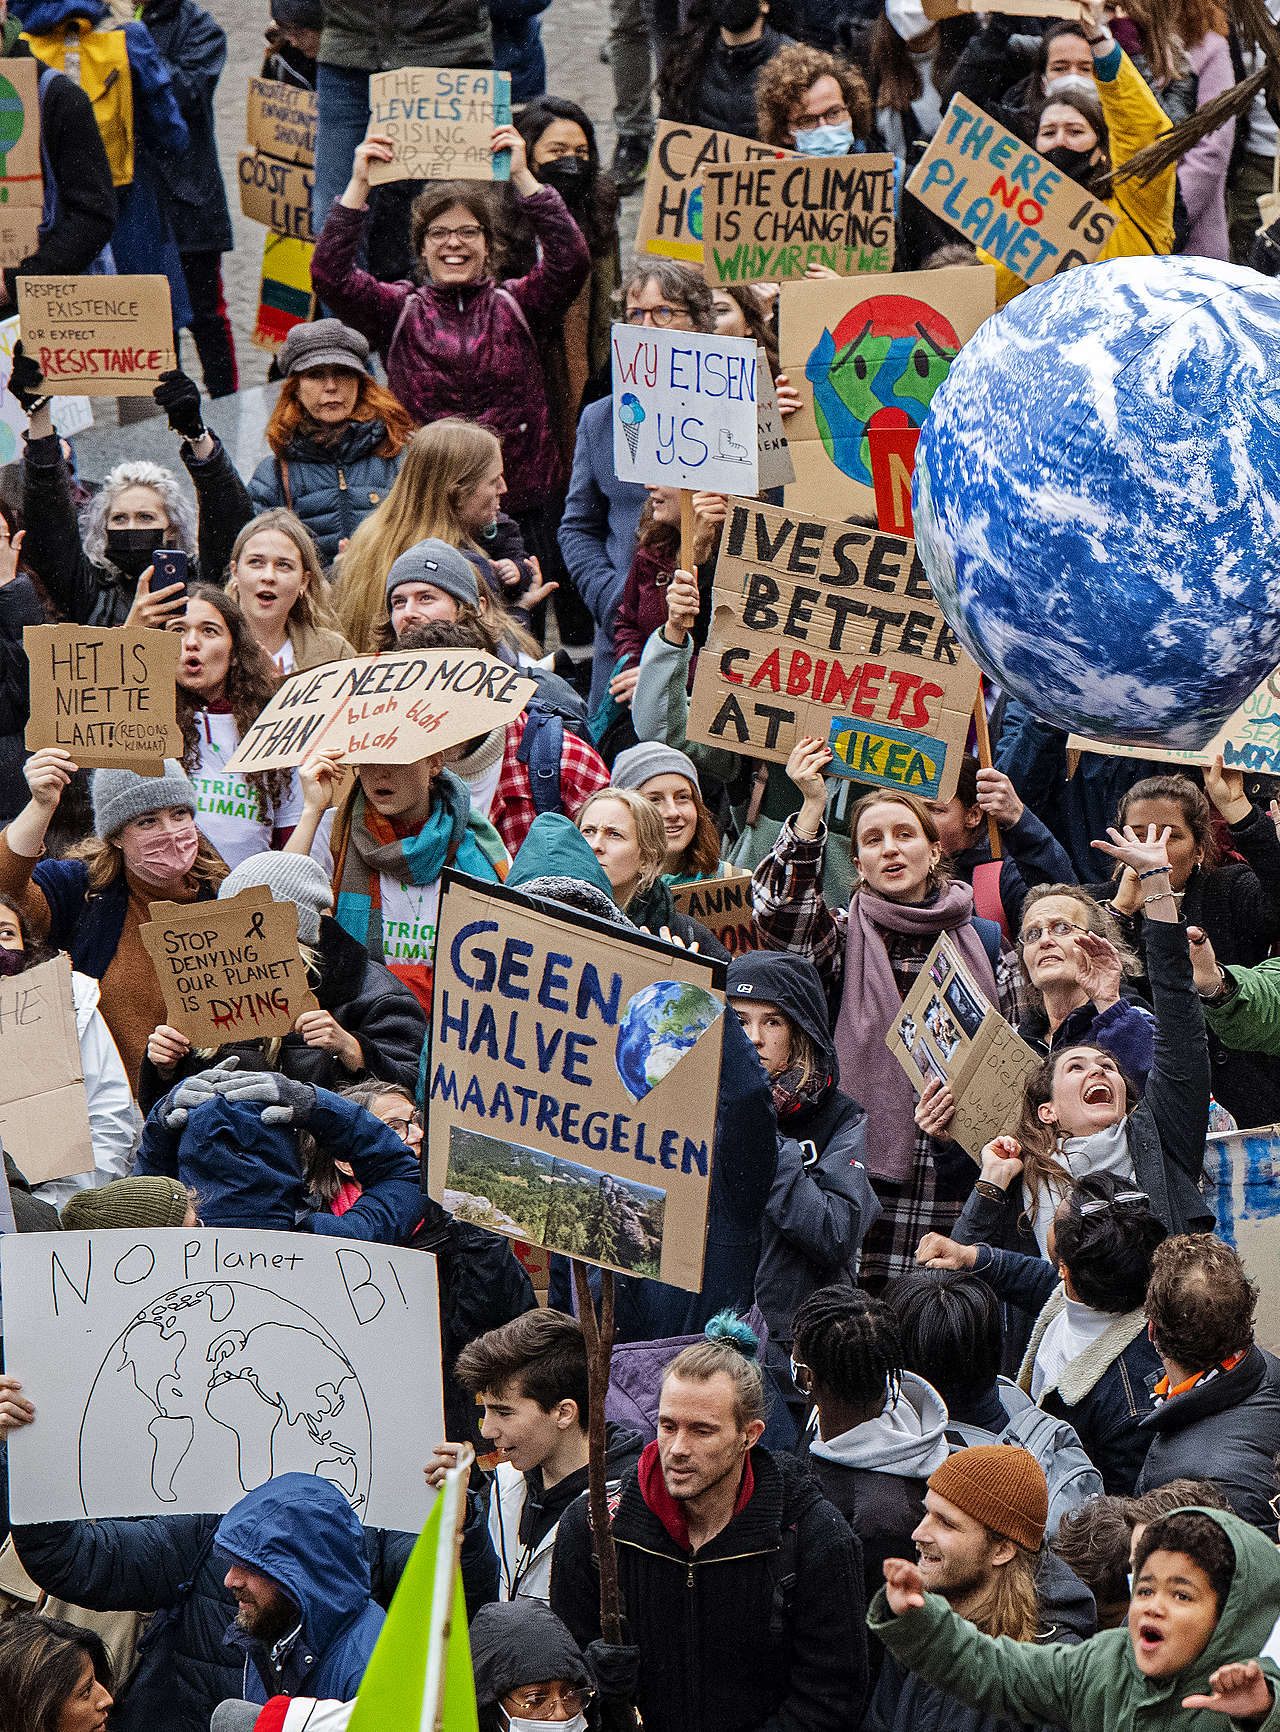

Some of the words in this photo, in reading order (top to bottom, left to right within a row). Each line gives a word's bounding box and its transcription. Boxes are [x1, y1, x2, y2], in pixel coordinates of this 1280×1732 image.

[375, 74, 425, 97] THE
[437, 73, 489, 97] SEA
[376, 98, 462, 123] LEVELS
[386, 123, 468, 146] RISING
[238, 156, 292, 196] COST
[707, 168, 776, 207] THE
[781, 166, 895, 214] CLIMATE
[946, 105, 1063, 206] THERE
[1068, 201, 1116, 244] IS
[920, 158, 1059, 280] PLANET
[989, 175, 1044, 226] NO
[714, 211, 742, 242] IS
[754, 211, 893, 249] CHANGING
[712, 243, 774, 283] WHY
[857, 246, 891, 273] WE
[24, 281, 78, 299] RESPECT
[47, 300, 139, 319] EXISTENCE
[28, 329, 46, 341] OR
[50, 329, 97, 341] EXPECT
[669, 346, 757, 403] EISEN
[726, 505, 828, 576] IVE
[818, 531, 934, 600] SEE
[742, 572, 960, 666] BETTER
[51, 641, 105, 684] HET
[120, 643, 149, 686] IS
[277, 669, 339, 711] WE
[332, 659, 428, 699] NEED
[425, 658, 522, 705] MORE
[56, 686, 120, 716] NIET
[122, 687, 151, 713] TE
[719, 646, 945, 729] CABINETS
[55, 720, 116, 749] LAAT!
[238, 713, 326, 764] THAN
[708, 692, 796, 750] AT
[844, 730, 936, 788] IKEA
[196, 796, 262, 823] LIMAT
[162, 929, 219, 955] STOP
[166, 944, 259, 975] DENYING
[176, 972, 219, 995] OUR
[221, 957, 296, 986] PLANET
[449, 919, 623, 1026] GEEN
[180, 995, 201, 1014] IS
[206, 986, 292, 1033] DYING
[439, 989, 598, 1087] HALVE
[430, 1061, 709, 1178] MAATREGELEN
[51, 1238, 156, 1317] NO
[334, 1247, 410, 1326] B!
